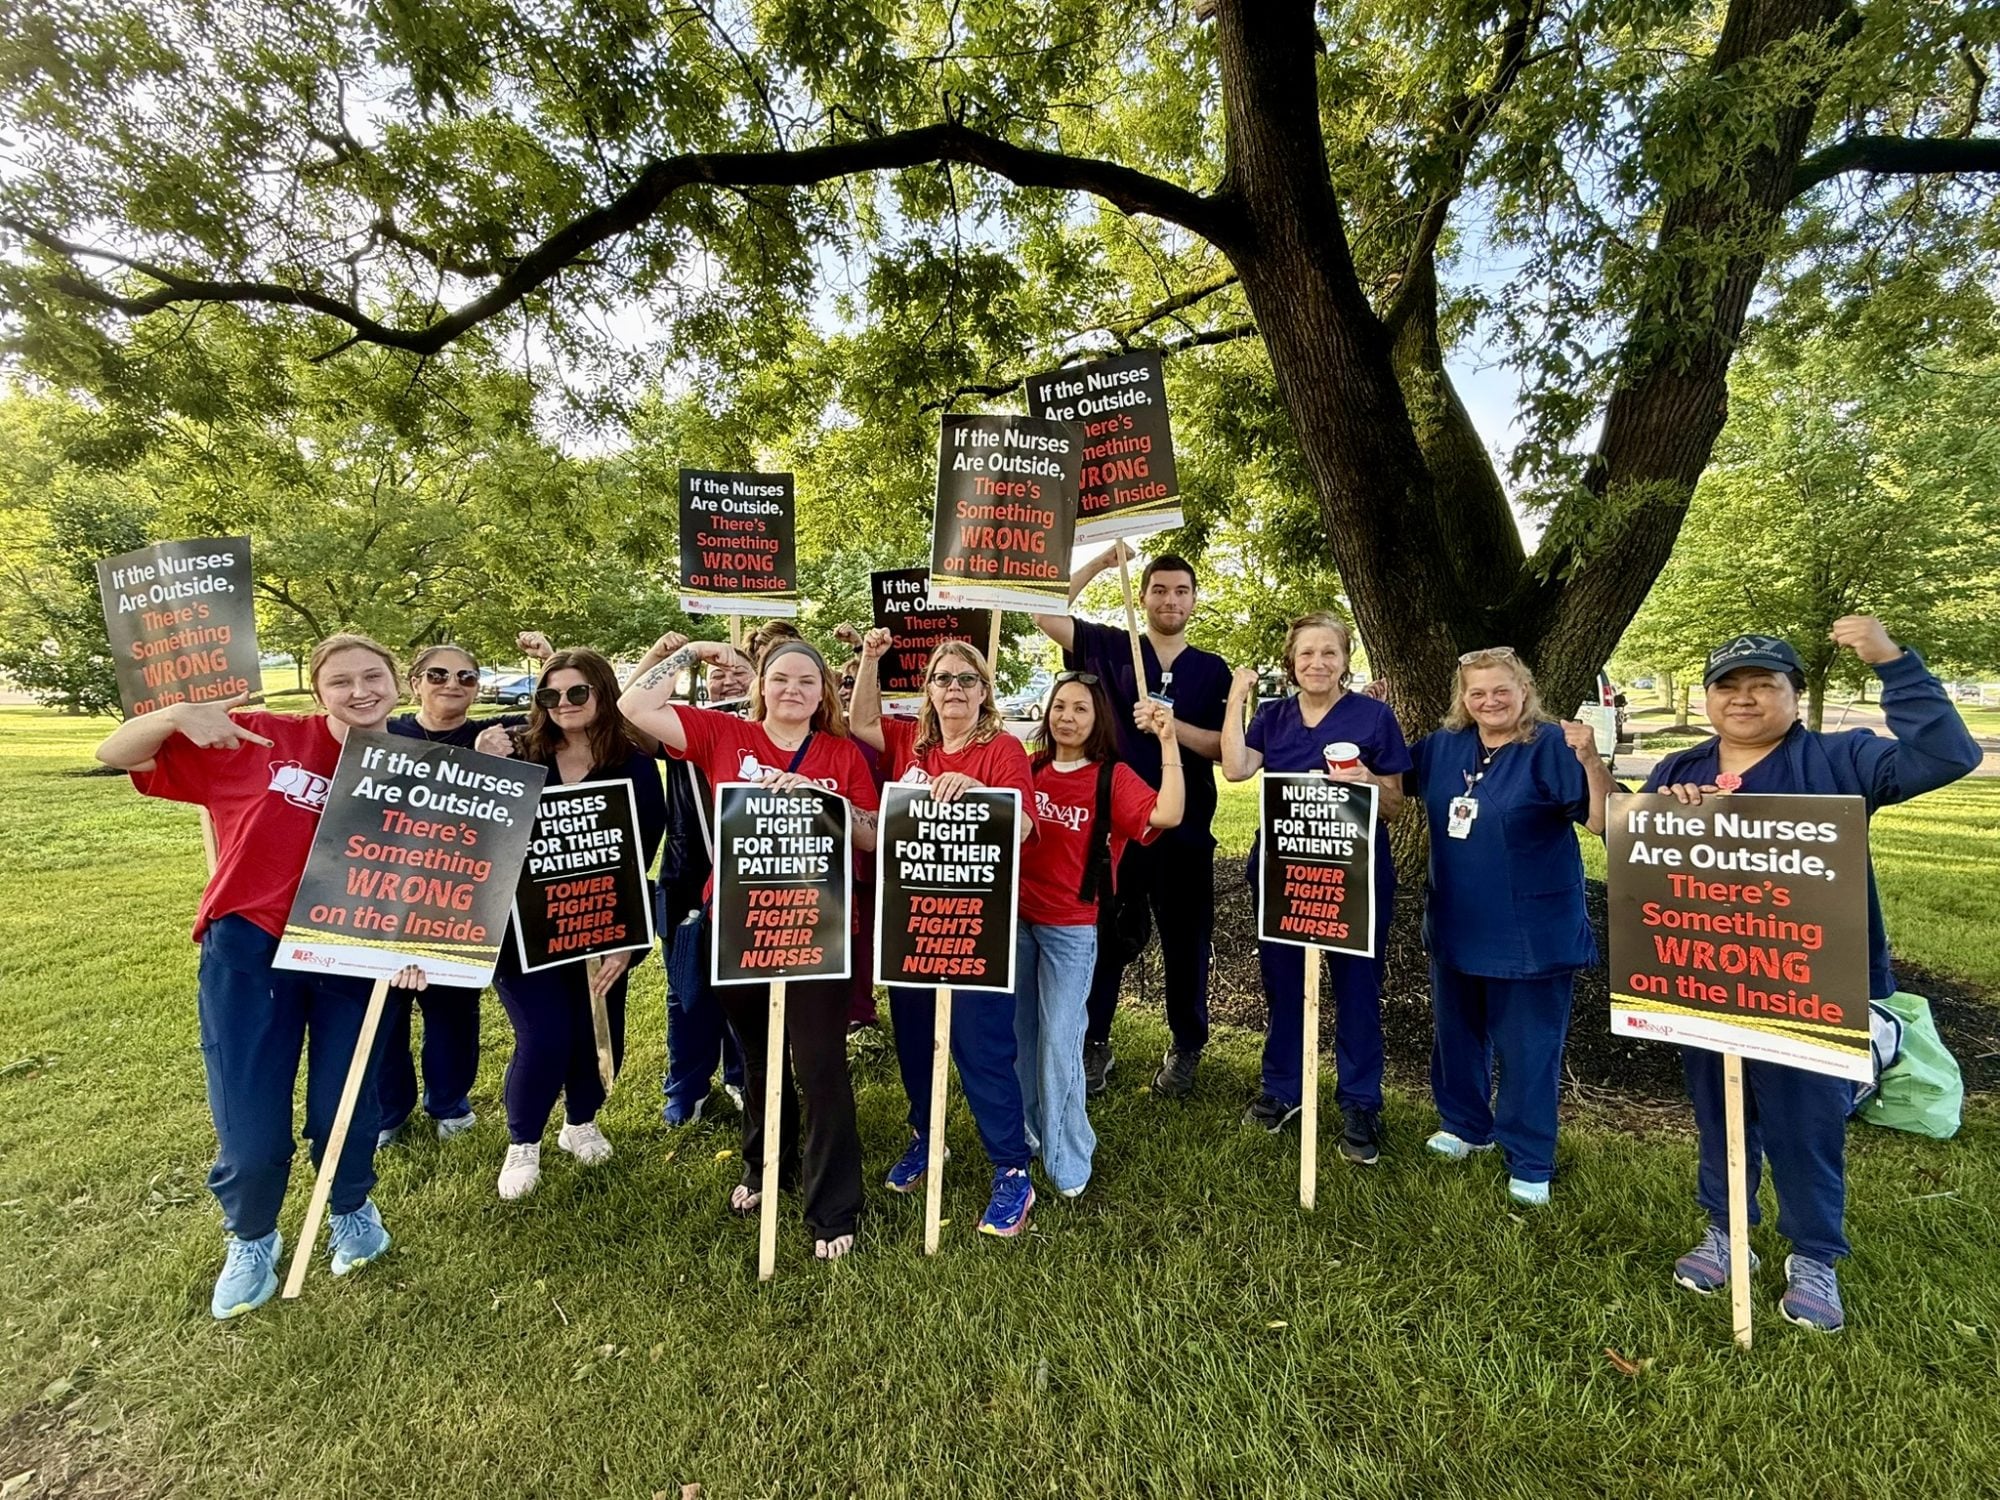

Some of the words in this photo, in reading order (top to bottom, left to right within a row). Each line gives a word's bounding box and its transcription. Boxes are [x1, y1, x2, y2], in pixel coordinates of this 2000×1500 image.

[1040, 384, 1052, 402] If
[1055, 381, 1084, 400] the
[1087, 367, 1150, 392] Nurses
[1045, 406, 1074, 421] Are
[1078, 389, 1152, 416] Outside,
[1085, 414, 1133, 438] ere's
[954, 428, 969, 446] If
[970, 429, 1000, 448] the
[1004, 429, 1070, 454] Nurses
[1082, 435, 1152, 461] mething
[953, 452, 984, 472] Are
[988, 452, 1065, 481] Outside,
[690, 478, 701, 492] If
[704, 479, 729, 494] the
[733, 482, 784, 496] Nurses
[974, 476, 1041, 499] There's
[1082, 494, 1110, 511] the
[1114, 482, 1168, 504] Inside
[690, 496, 718, 511] Are
[722, 498, 784, 516] Outside,
[956, 501, 1054, 529] Something
[710, 516, 766, 532] There's
[697, 532, 778, 552] Something
[960, 526, 1046, 554] WRONG
[112, 570, 124, 589] If
[127, 565, 154, 584] the
[158, 552, 234, 576] Nurses
[703, 552, 774, 572] WRONG
[944, 556, 964, 571] on
[969, 556, 998, 573] the
[1003, 556, 1059, 578] Inside
[690, 574, 709, 586] on
[714, 574, 738, 588] the
[742, 575, 786, 590] Inside
[882, 580, 893, 594] If
[896, 579, 920, 594] the
[118, 594, 147, 614] Are
[150, 574, 234, 603] Outside,
[143, 602, 209, 631] There's
[885, 599, 910, 612] Are
[904, 615, 958, 630] There's
[132, 625, 231, 660] Something
[142, 648, 228, 689] WRONG
[890, 677, 904, 688] on
[912, 674, 924, 687] th
[134, 700, 154, 716] on
[159, 691, 185, 708] the
[189, 677, 248, 702] Inside
[361, 746, 384, 769] If
[387, 752, 430, 778] the
[435, 760, 525, 797] Nurses
[352, 776, 401, 804] Are
[408, 785, 514, 828] Outside,
[1282, 786, 1349, 802] NURSES
[746, 798, 823, 815] NURSES
[908, 800, 990, 822] NURSES
[1290, 804, 1339, 819] FIGHT
[382, 810, 478, 846] There's
[540, 814, 598, 836] FIGHT
[756, 817, 813, 834] FIGHT
[918, 822, 978, 842] FIGHT
[1274, 820, 1304, 834] FOR
[1310, 822, 1358, 838] THEIR
[1628, 810, 1648, 834] If
[1654, 812, 1705, 837] the
[1714, 813, 1838, 842] Nurses
[566, 828, 623, 849] THEIR
[732, 838, 776, 855] FOR
[778, 836, 834, 854] THEIR
[1278, 836, 1353, 856] PATIENTS
[344, 835, 492, 882] Something
[529, 846, 621, 874] PATIENTS
[895, 840, 937, 860] FOR
[943, 842, 1000, 864] THEIR
[1628, 841, 1682, 866] Are
[1690, 844, 1836, 882] Outside,
[738, 856, 828, 875] PATIENTS
[900, 862, 994, 883] PATIENTS
[1286, 864, 1344, 884] TOWER
[346, 867, 474, 910] WRONG
[545, 876, 614, 900] TOWER
[748, 888, 820, 907] TOWER
[1284, 882, 1345, 902] FIGHTS
[1667, 874, 1791, 907] There's
[546, 892, 617, 918] FIGHTS
[909, 896, 983, 915] TOWER
[1290, 900, 1340, 919] THEIR
[310, 904, 345, 924] on
[353, 906, 398, 932] the
[404, 912, 486, 942] Inside
[556, 910, 614, 934] THEIR
[745, 908, 820, 928] FIGHTS
[907, 916, 983, 936] FIGHTS
[1280, 916, 1349, 939] NURSES
[1642, 902, 1824, 950] Something
[548, 924, 626, 954] NURSES
[753, 929, 813, 947] THEIR
[915, 936, 976, 955] THEIR
[740, 947, 823, 968] NURSES
[902, 954, 986, 976] NURSES
[1654, 935, 1810, 984] WRONG
[1630, 973, 1668, 994] on
[1676, 976, 1728, 1004] the
[1737, 983, 1844, 1024] Inside
